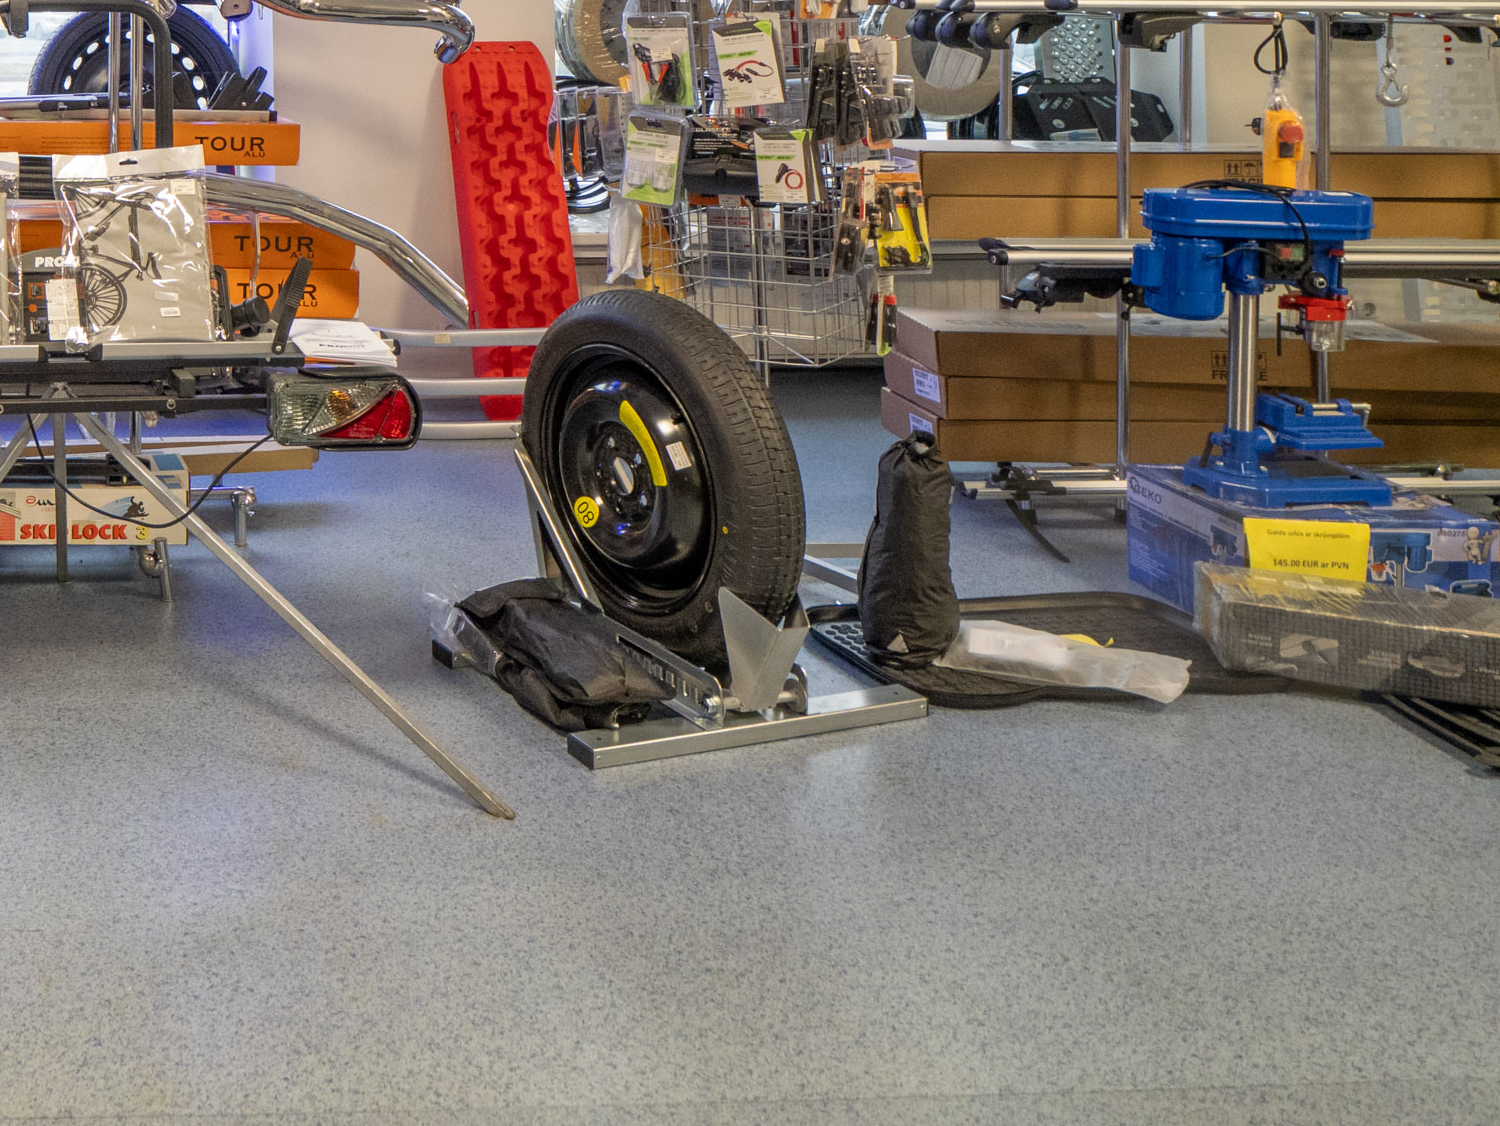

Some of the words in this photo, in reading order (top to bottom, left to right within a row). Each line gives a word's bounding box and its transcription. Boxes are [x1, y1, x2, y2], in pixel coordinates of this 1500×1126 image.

[194, 136, 265, 152] TOUR
[244, 150, 265, 158] ALU
[234, 235, 314, 253] TOUR
[1273, 558, 1301, 567] 145.00
[1302, 560, 1318, 568] EUR
[1331, 561, 1350, 570] PVN
